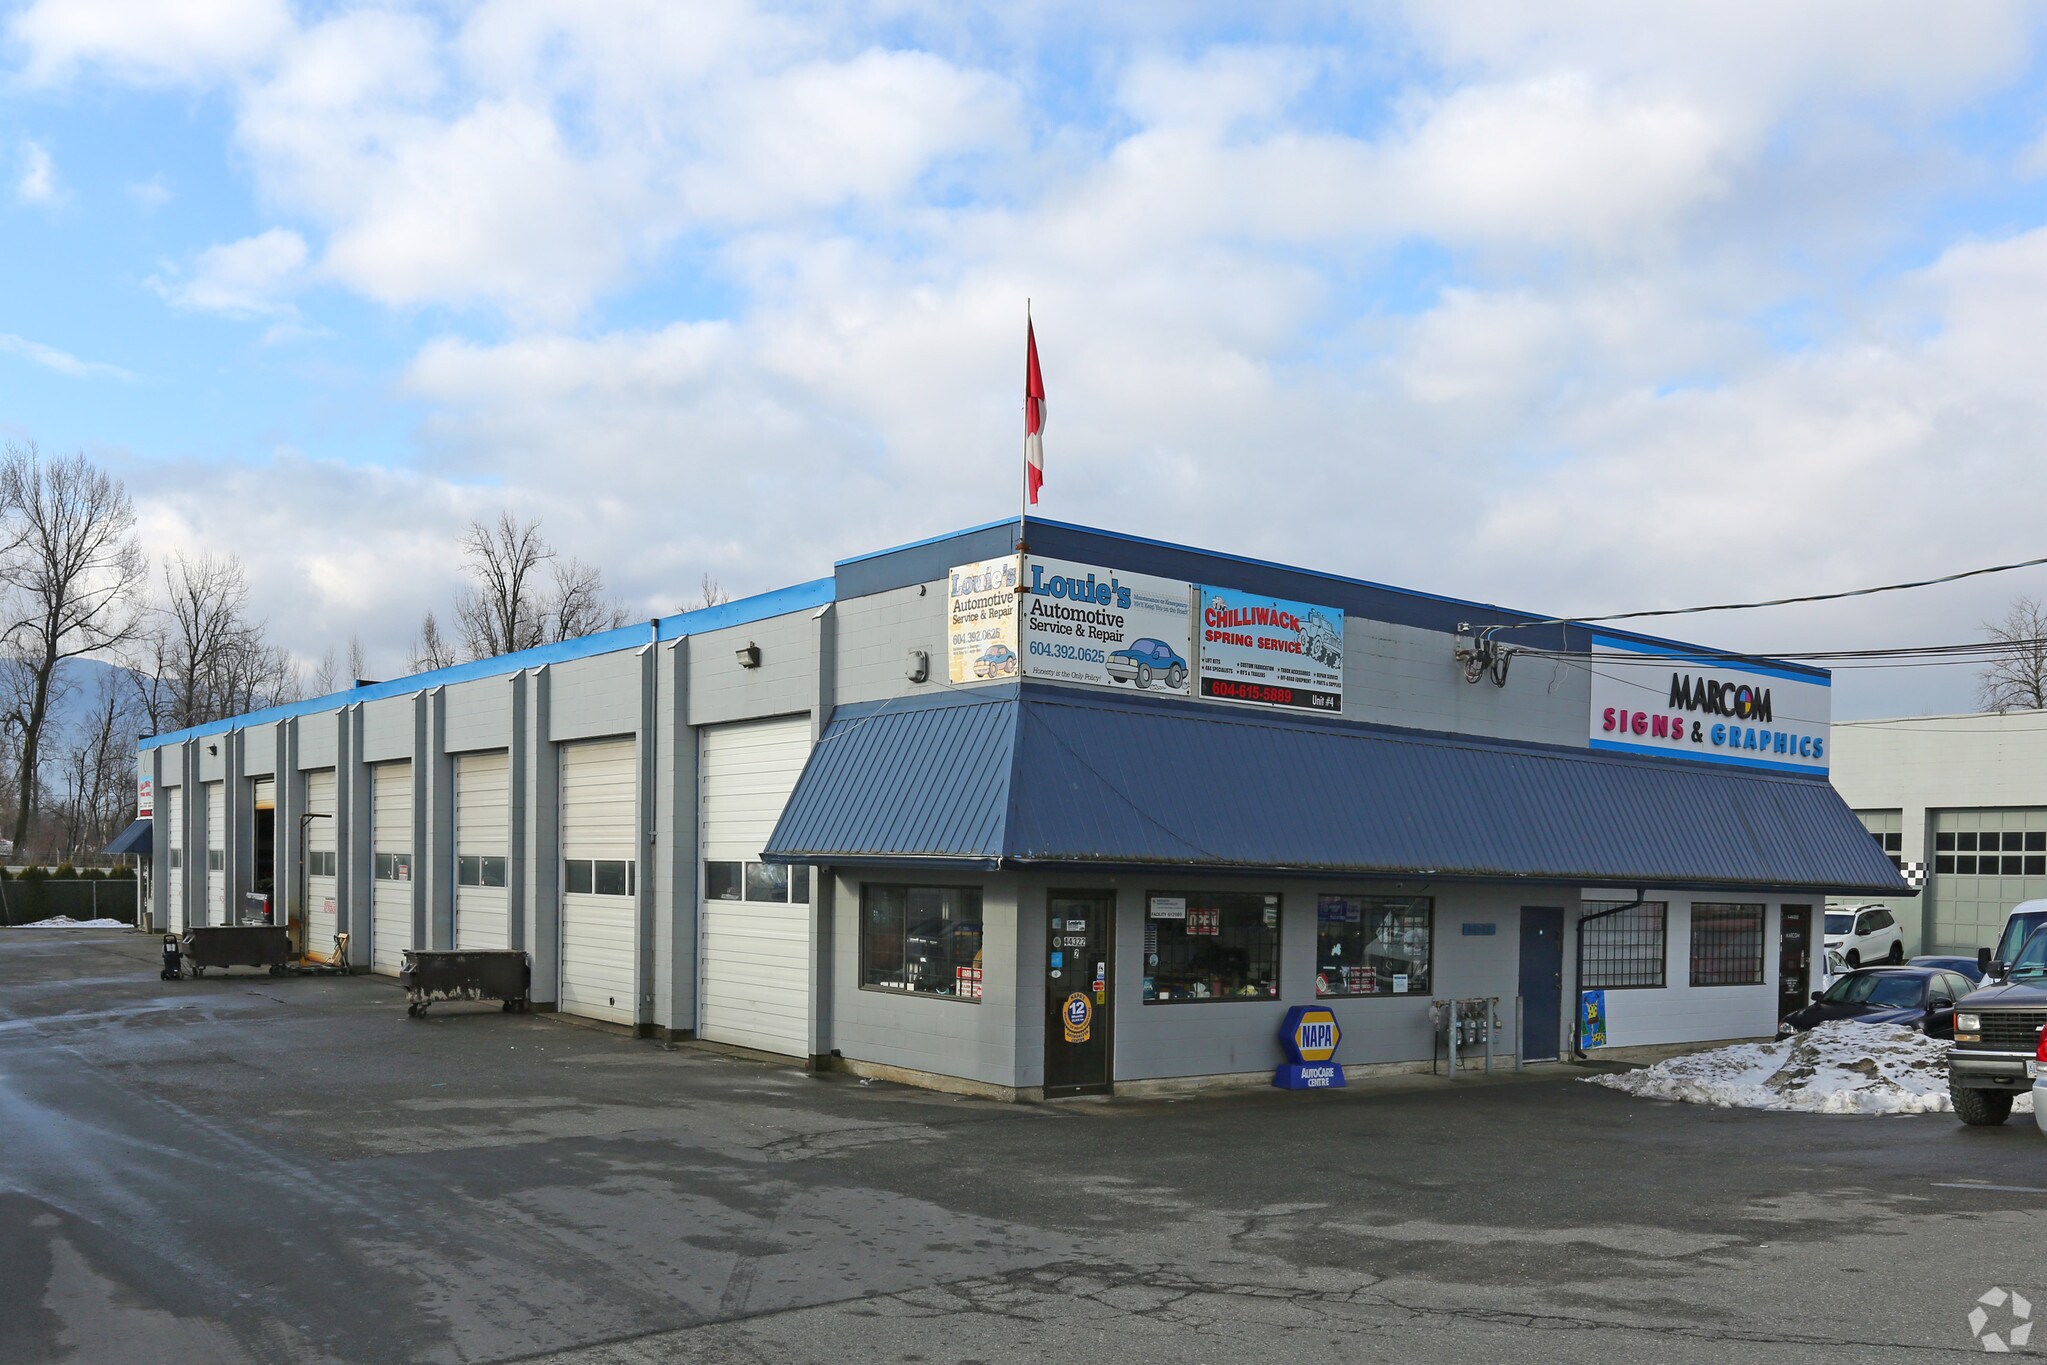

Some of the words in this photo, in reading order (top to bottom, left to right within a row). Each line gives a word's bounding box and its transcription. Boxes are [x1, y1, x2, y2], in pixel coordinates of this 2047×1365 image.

[951, 564, 1016, 597] Louie's
[1031, 564, 1131, 609] Louie's
[953, 591, 1013, 613] Automotive
[1030, 598, 1124, 628] Automotive
[953, 611, 978, 625] Service
[981, 609, 987, 620] &
[989, 605, 1013, 619] Repair
[1205, 607, 1300, 633] CHILLIWACK
[953, 628, 1000, 645] 604.392.0625
[1030, 617, 1072, 635] Service
[1076, 624, 1085, 637] &
[1088, 626, 1124, 643] Repair
[1030, 640, 1105, 664] 604.392.0625
[1205, 629, 1253, 647] SPRING
[1258, 637, 1302, 654] SERVICE
[1032, 666, 1055, 677] Honesty
[1061, 670, 1070, 678] the
[1071, 671, 1084, 680] Only
[1212, 681, 1292, 703] 604-615-5889
[1312, 694, 1325, 706] Unit
[1325, 696, 1334, 707] #4
[1669, 672, 1772, 723] MARCOM
[1603, 707, 1684, 740] SIGNS
[1691, 720, 1704, 743] &
[1711, 723, 1824, 759] GRAPHICS
[1064, 936, 1086, 946] 44322
[1074, 949, 1079, 959] 2
[1069, 1001, 1085, 1014] 12
[1302, 1025, 1332, 1047] NAPA
[1308, 1078, 1330, 1087] CENTRE
